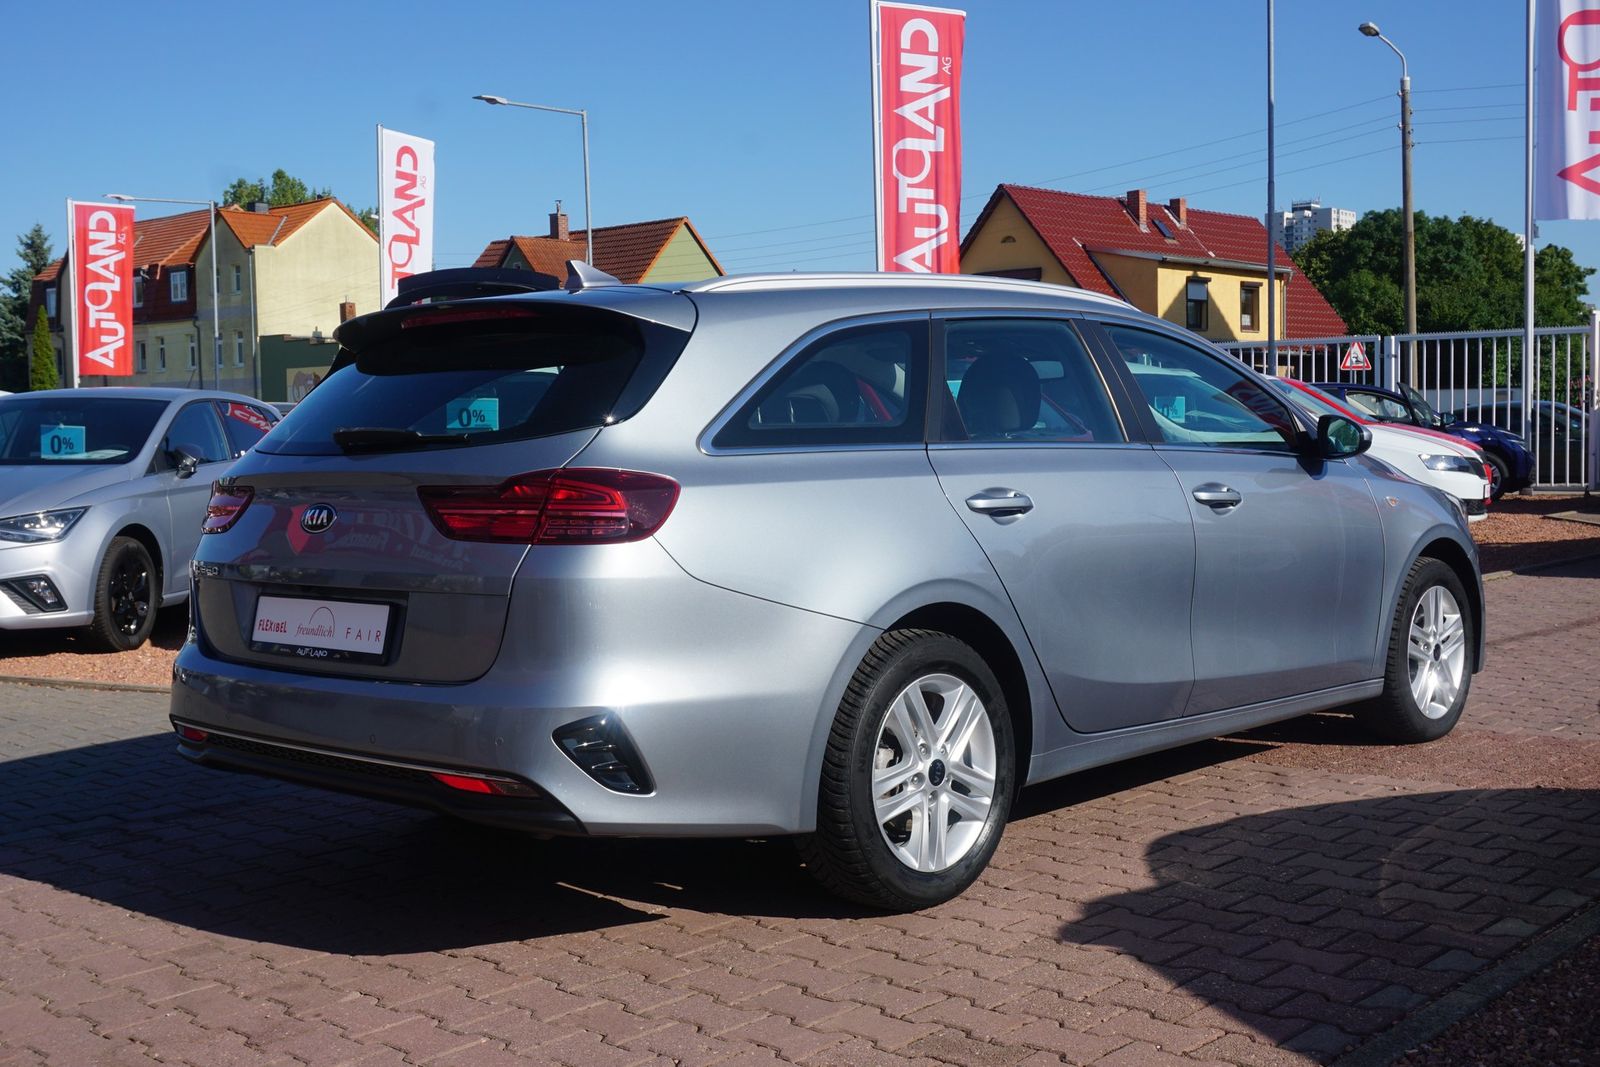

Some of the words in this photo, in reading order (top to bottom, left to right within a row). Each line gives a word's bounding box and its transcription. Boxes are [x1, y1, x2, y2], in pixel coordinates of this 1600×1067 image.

[941, 56, 952, 75] AG
[892, 18, 951, 273] AUTOLAND
[388, 145, 426, 289] TOLAND
[118, 233, 127, 245] AG
[84, 210, 126, 369] AUTOLAND
[458, 408, 486, 427] 0%
[50, 434, 75, 454] 0%
[257, 619, 288, 633] FLEXIBEL
[295, 623, 333, 638] freundlich
